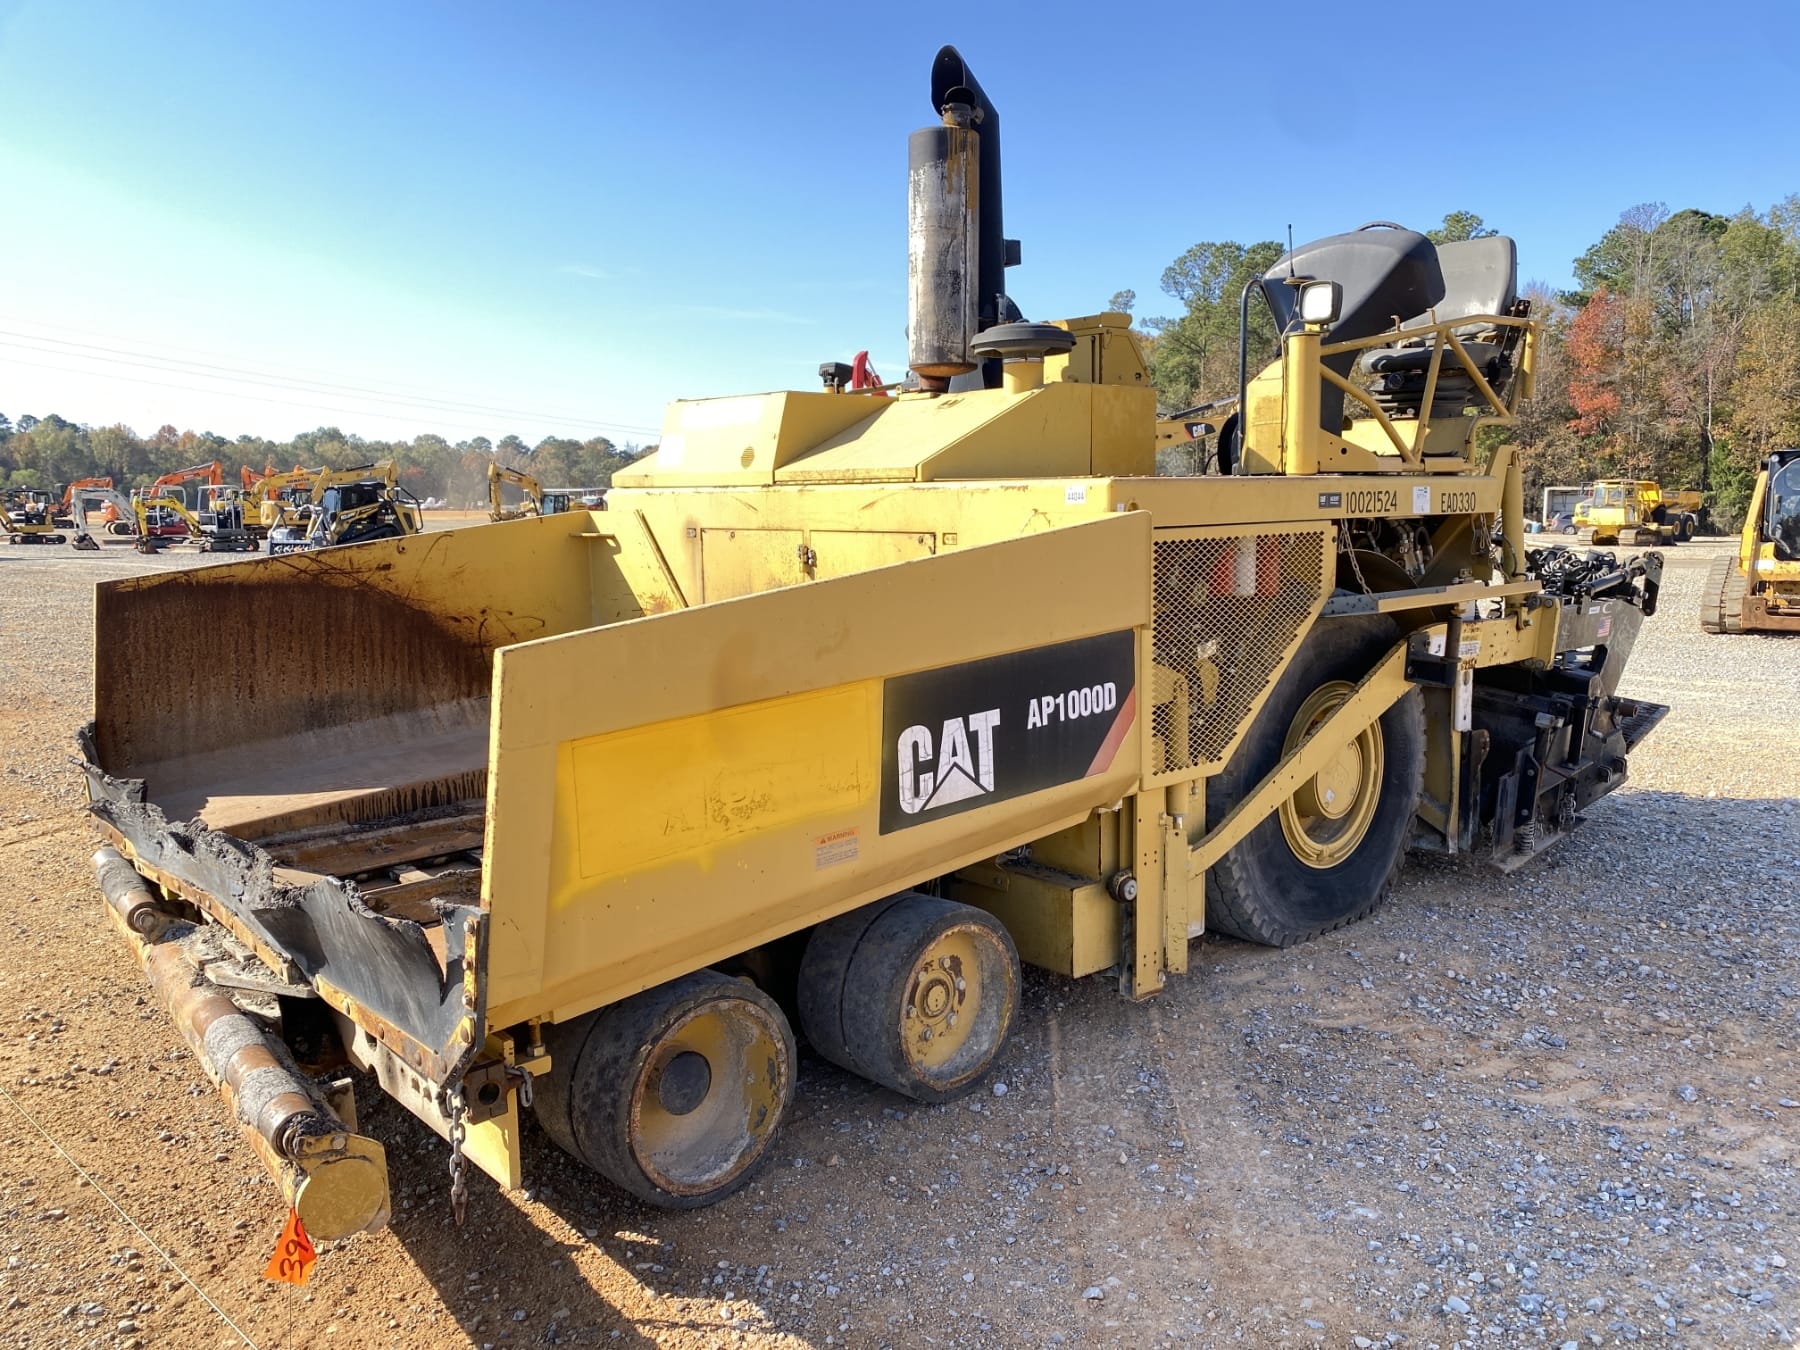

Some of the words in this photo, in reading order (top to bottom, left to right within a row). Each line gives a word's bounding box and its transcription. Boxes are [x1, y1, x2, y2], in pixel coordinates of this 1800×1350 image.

[1192, 424, 1206, 437] CAT
[1345, 490, 1398, 514] 10021524
[1440, 491, 1476, 513] EAD330
[1027, 682, 1117, 730] AP1000D
[897, 708, 1001, 815] CAT
